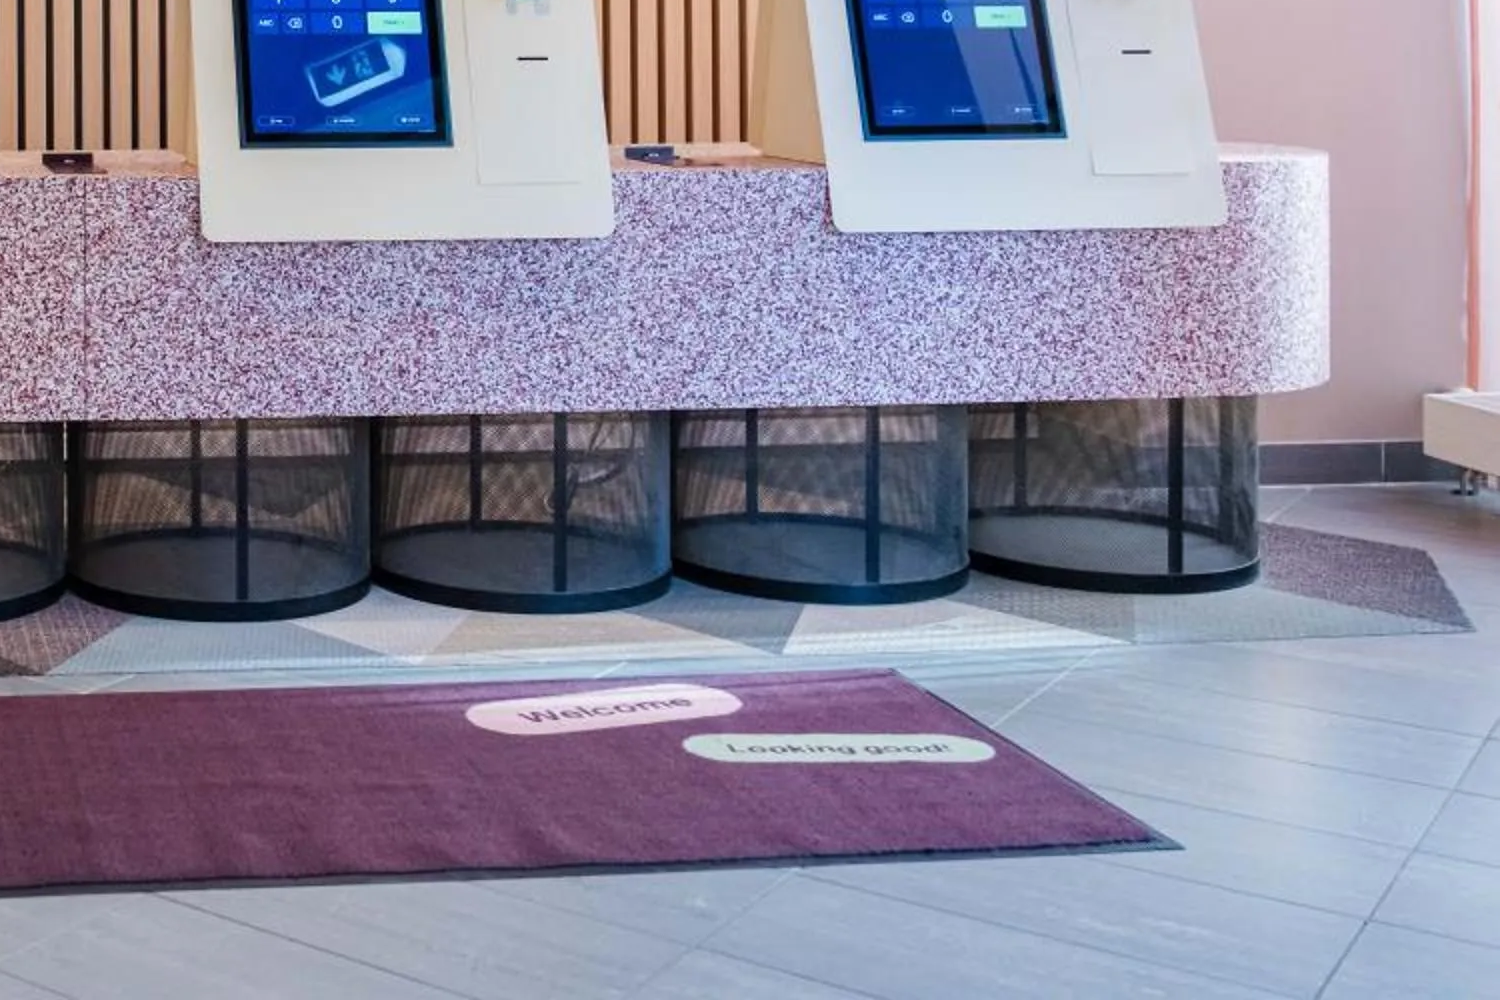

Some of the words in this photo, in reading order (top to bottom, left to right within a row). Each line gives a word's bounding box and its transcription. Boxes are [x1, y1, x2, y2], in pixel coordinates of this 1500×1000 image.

[332, 16, 342, 29] 0
[942, 10, 952, 23] 0
[518, 697, 692, 724] Welcome
[726, 743, 857, 756] Looking
